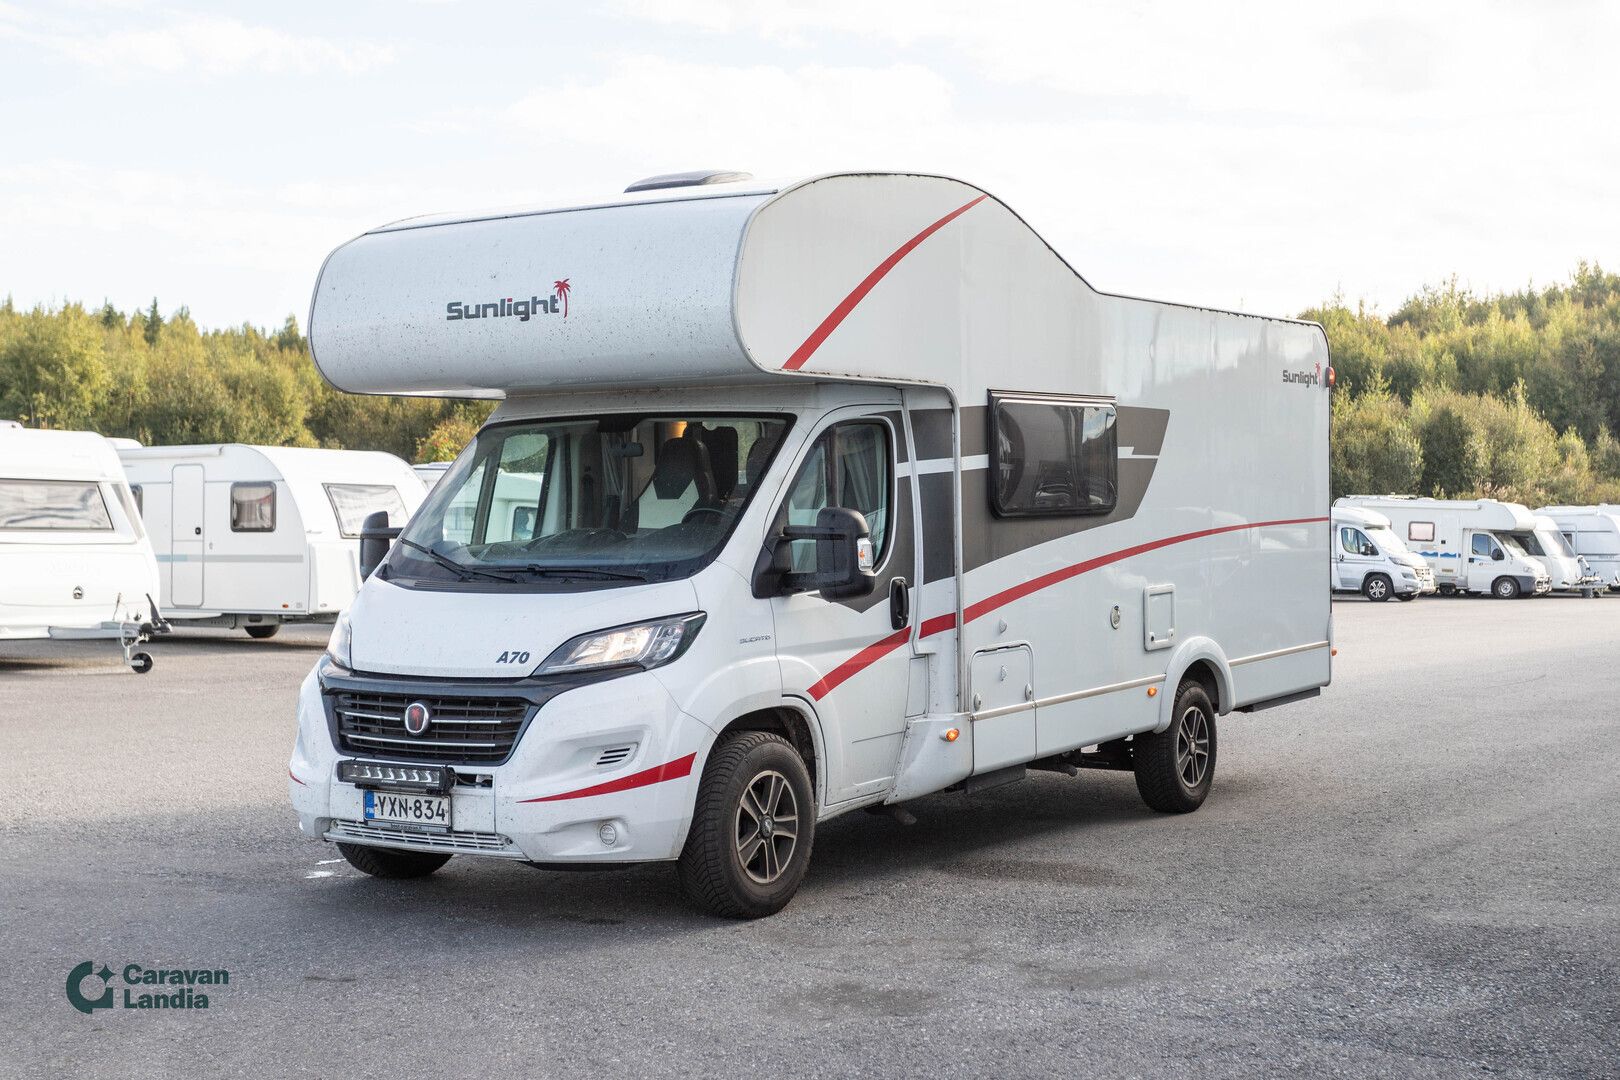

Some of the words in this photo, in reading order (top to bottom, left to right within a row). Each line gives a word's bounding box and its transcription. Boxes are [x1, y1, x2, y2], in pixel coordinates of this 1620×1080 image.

[446, 294, 560, 322] Sunlight
[1282, 369, 1318, 388] Sunlight
[496, 651, 530, 664] A70
[377, 795, 446, 821] YXN-834
